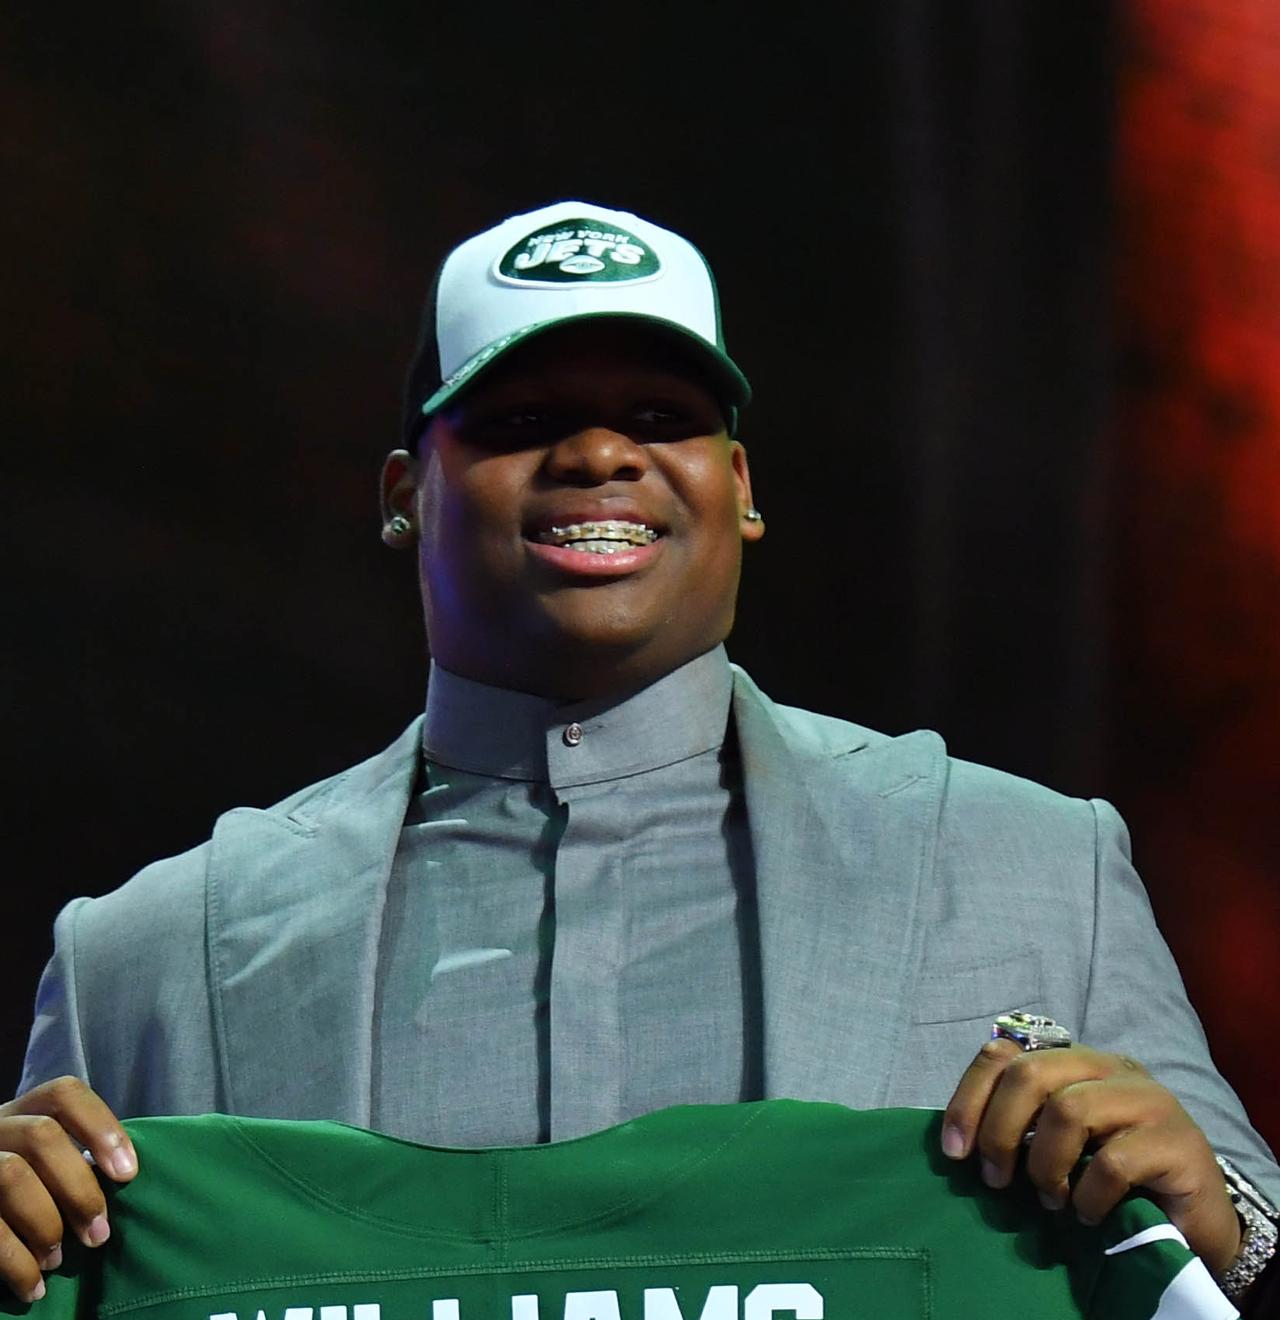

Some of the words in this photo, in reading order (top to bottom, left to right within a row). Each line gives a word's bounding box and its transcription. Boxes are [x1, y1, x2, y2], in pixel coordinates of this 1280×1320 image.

[528, 231, 575, 247] NEW
[577, 230, 630, 244] YORK
[513, 238, 646, 270] JETS
